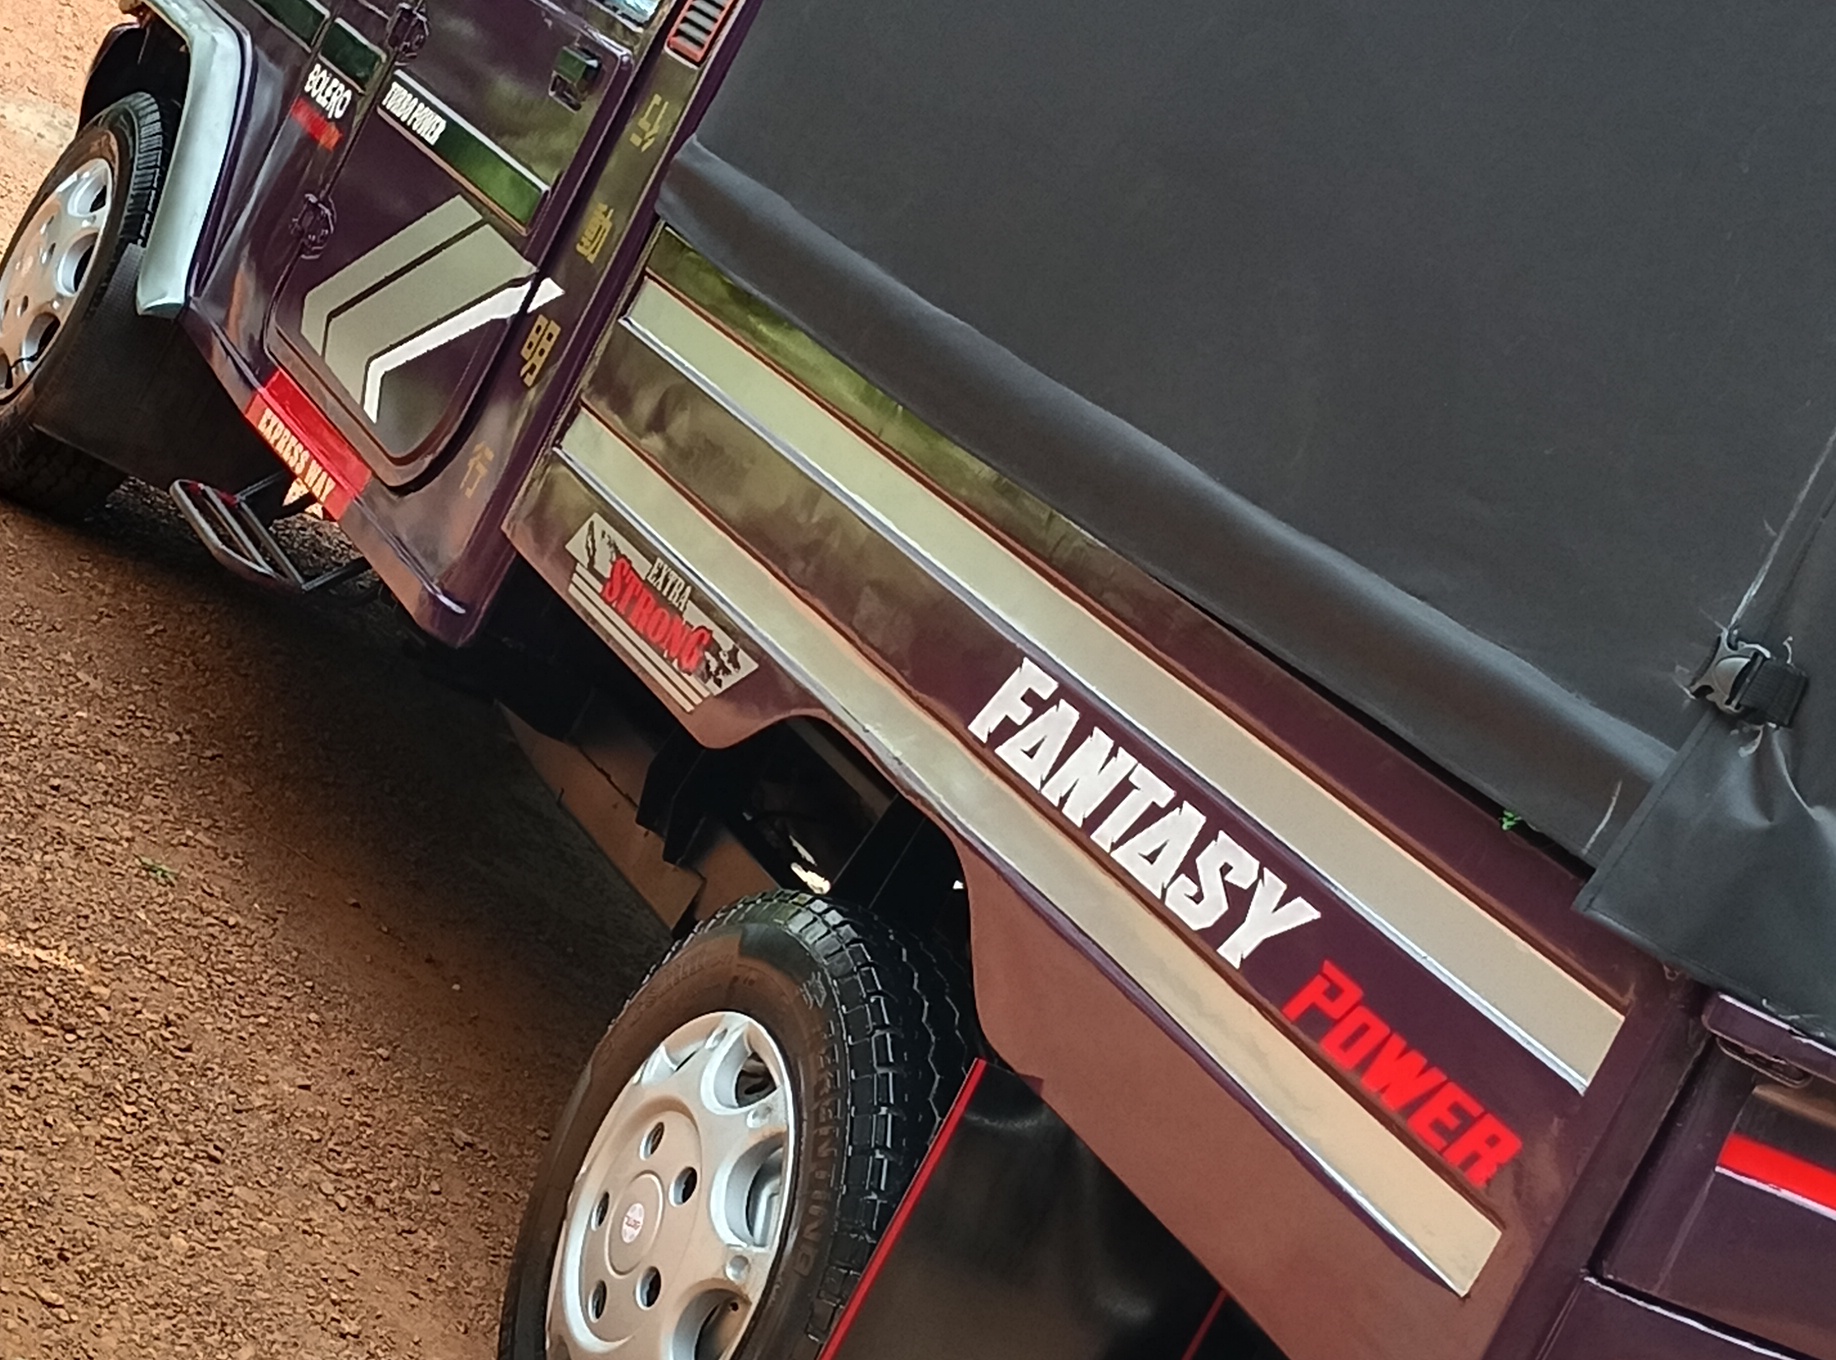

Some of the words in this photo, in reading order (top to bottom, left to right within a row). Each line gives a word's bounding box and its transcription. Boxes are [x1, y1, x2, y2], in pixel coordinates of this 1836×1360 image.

[304, 64, 351, 119] BOLERO
[257, 407, 310, 476] EXPRESS
[304, 459, 337, 505] WAY
[602, 554, 713, 676] STRONG
[646, 557, 692, 612] EXTRA
[967, 656, 1322, 970] FANTASY
[1280, 959, 1524, 1190] POWER
